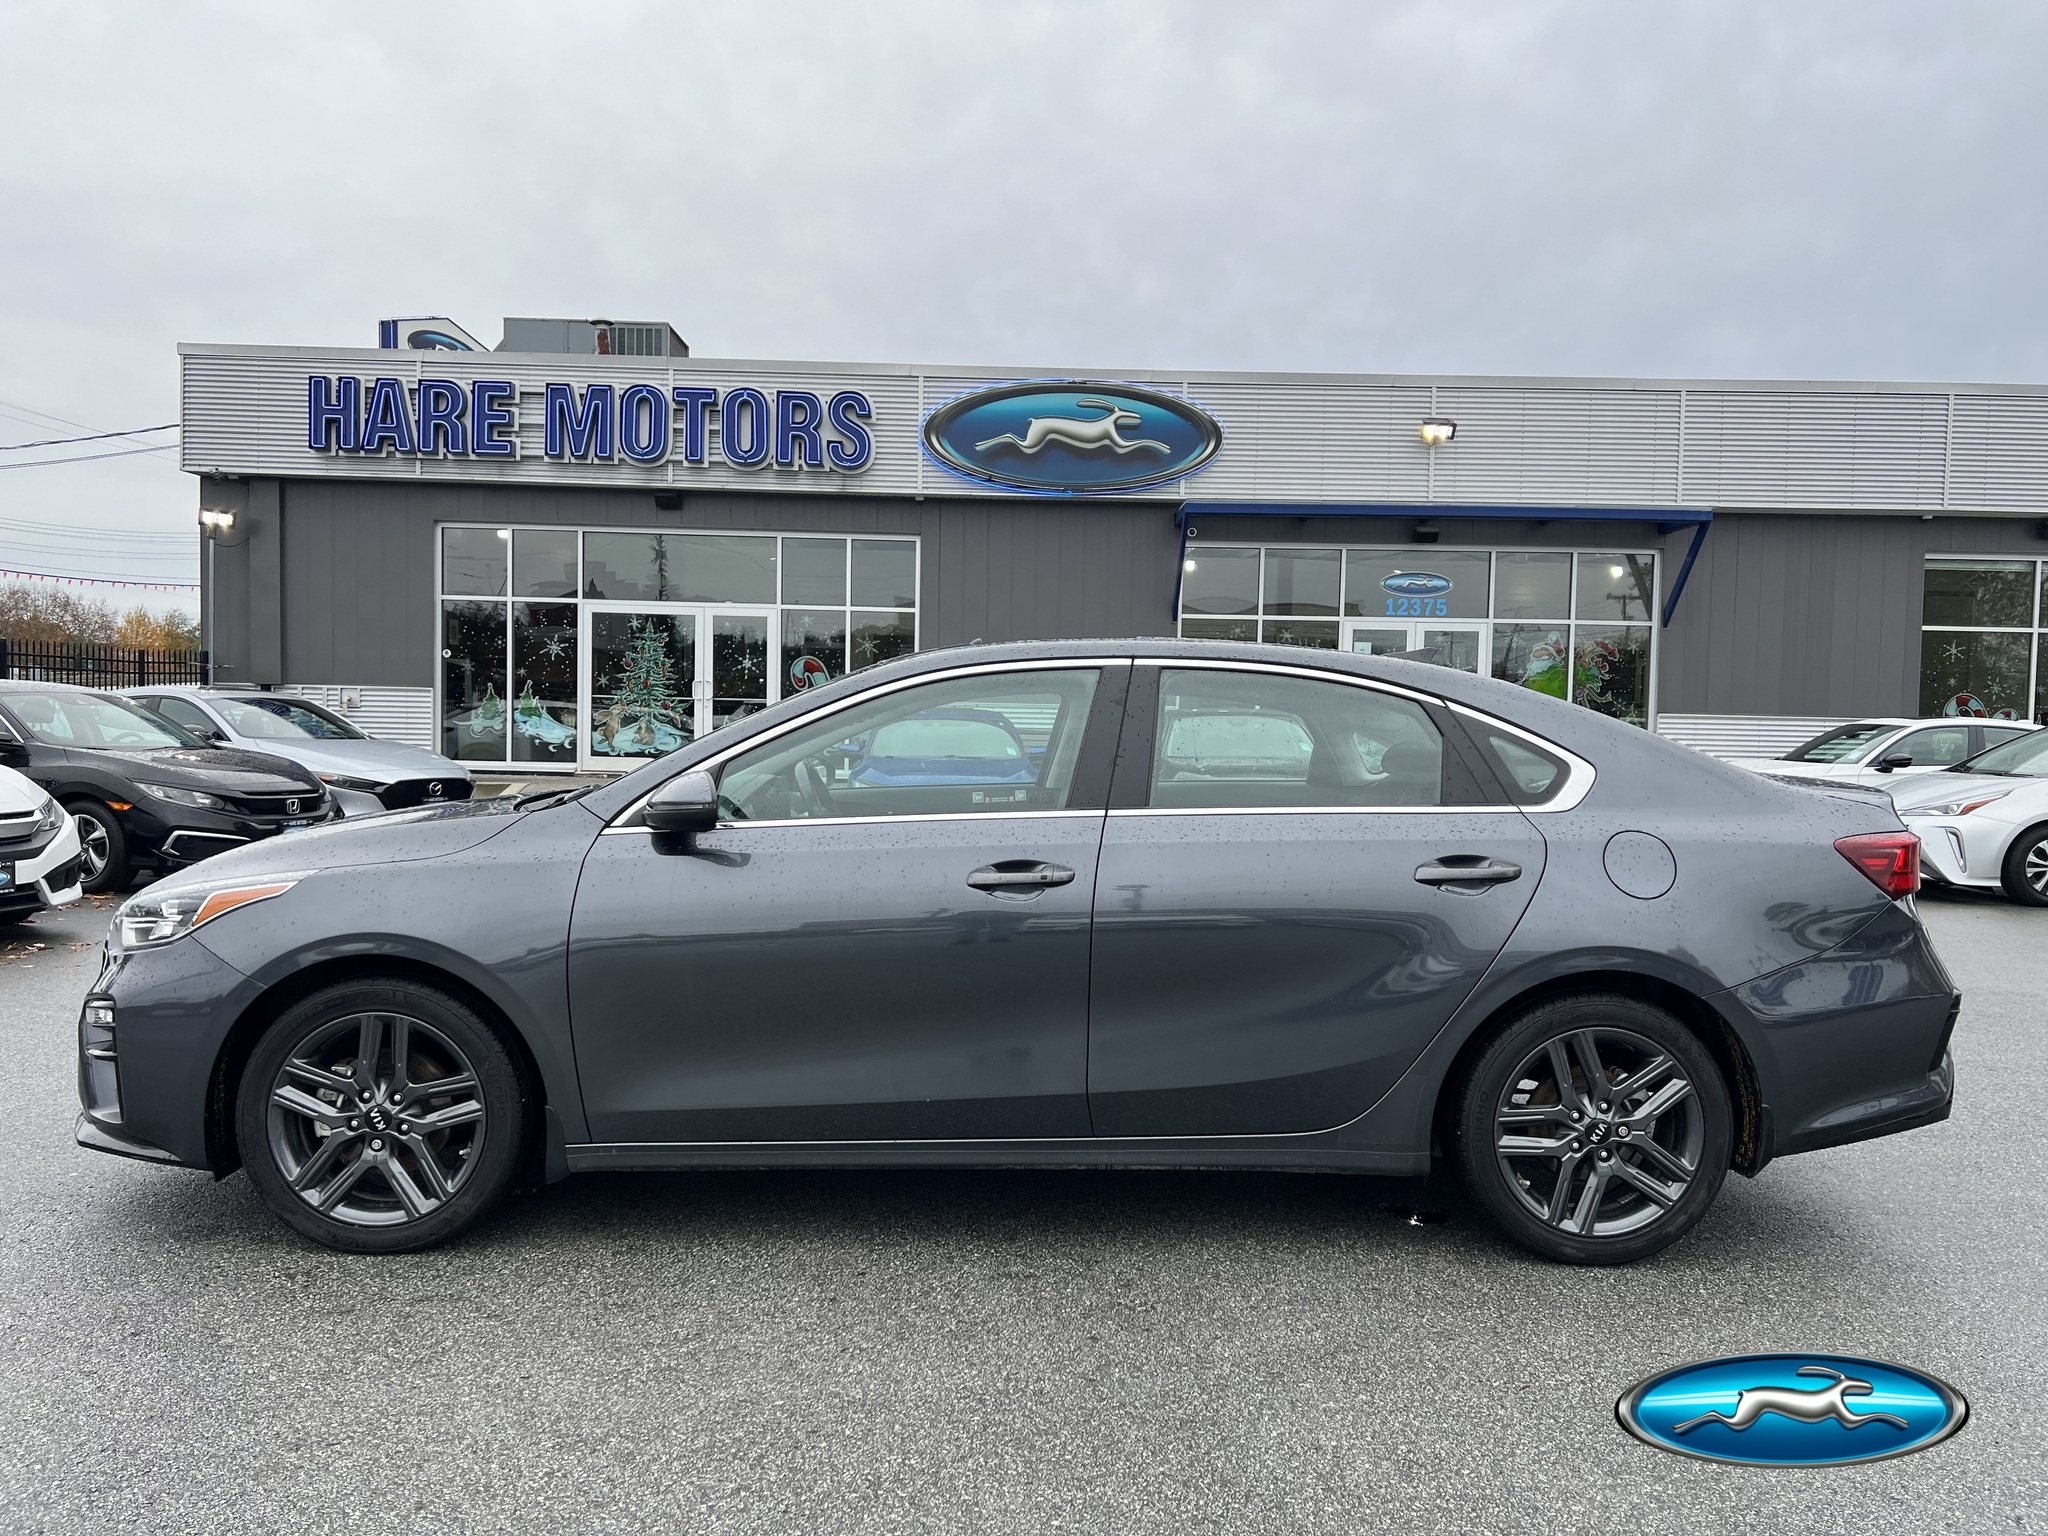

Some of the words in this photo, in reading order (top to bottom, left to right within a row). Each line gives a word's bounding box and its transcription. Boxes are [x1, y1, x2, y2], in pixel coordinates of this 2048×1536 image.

[308, 375, 516, 457] HARE
[545, 382, 874, 470] MOTORS
[1385, 597, 1448, 617] 12375
[369, 1107, 387, 1131] KIA
[1589, 1122, 1608, 1143] KIA
